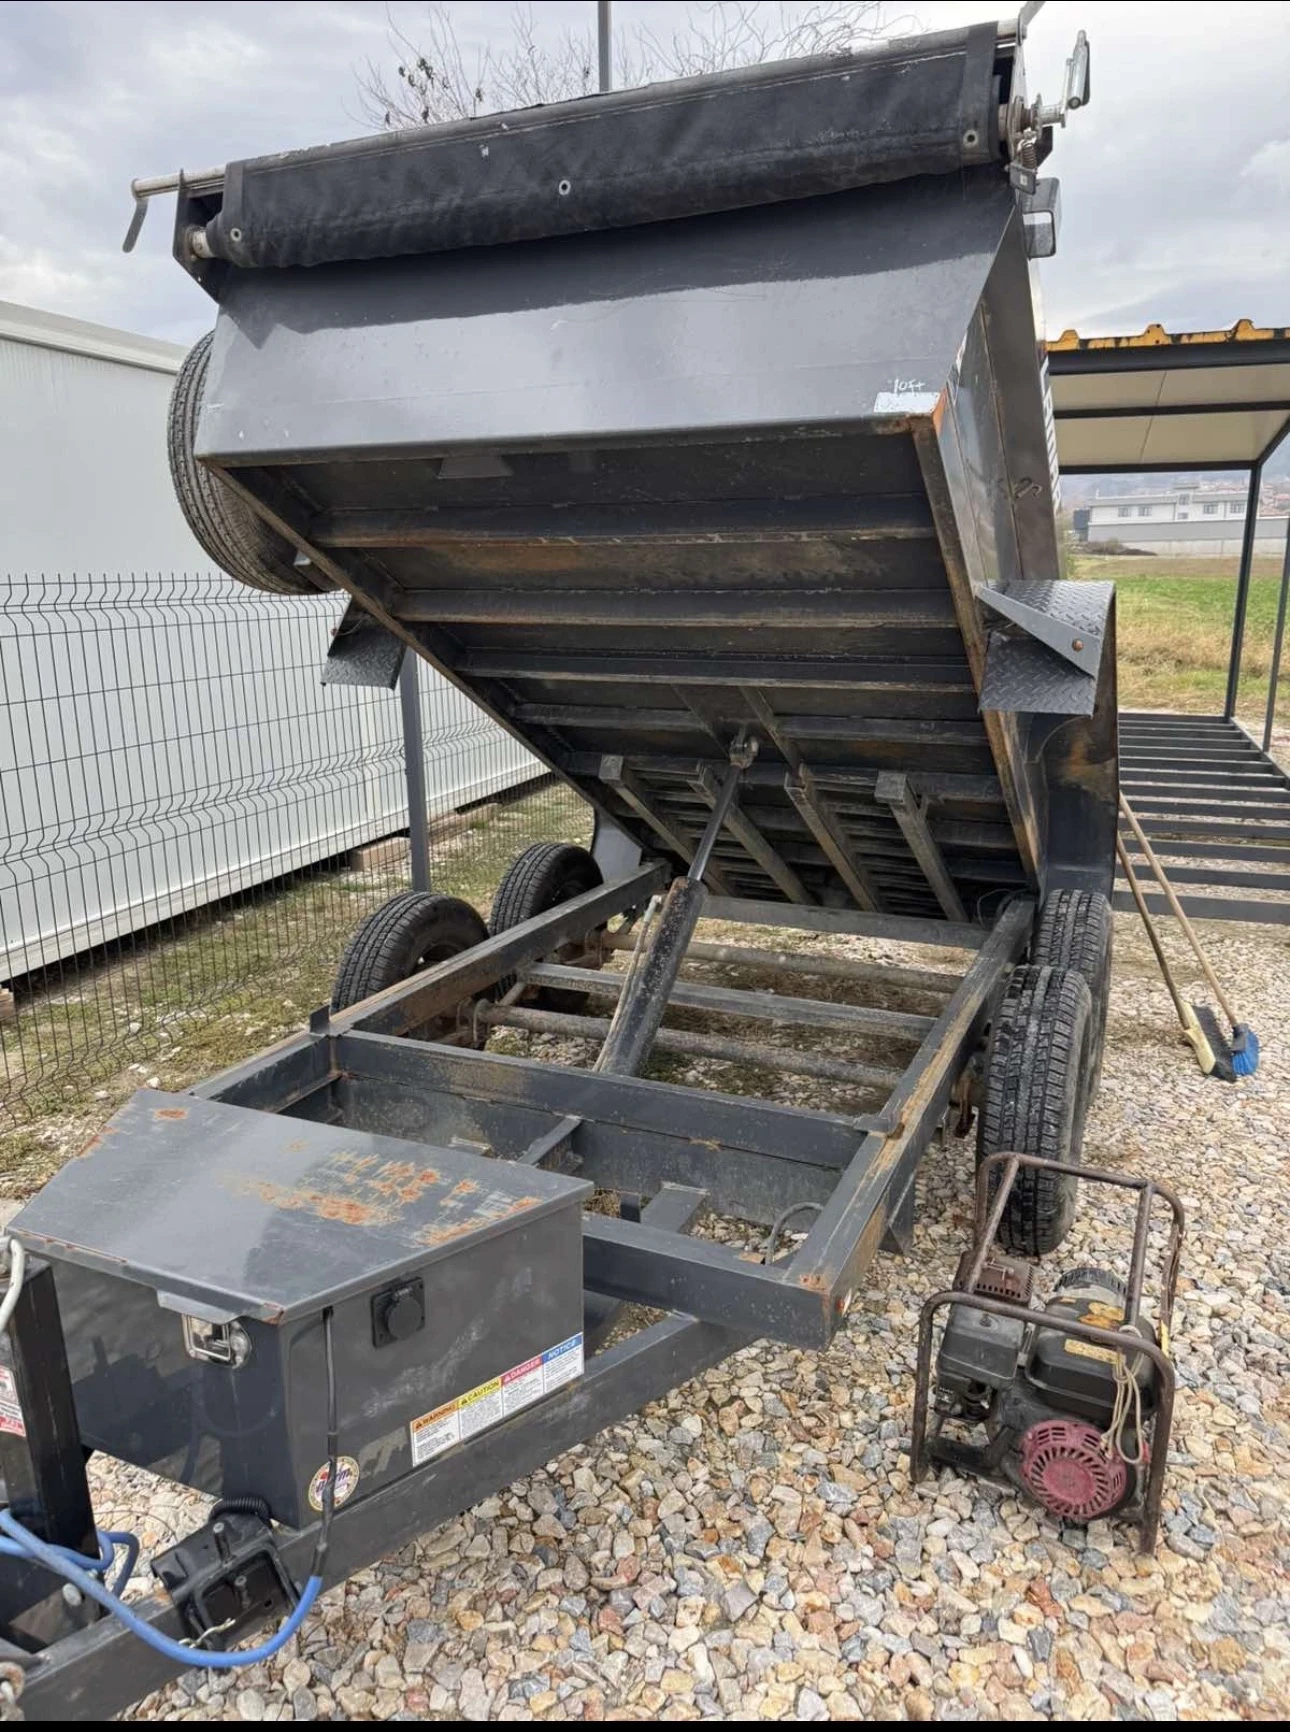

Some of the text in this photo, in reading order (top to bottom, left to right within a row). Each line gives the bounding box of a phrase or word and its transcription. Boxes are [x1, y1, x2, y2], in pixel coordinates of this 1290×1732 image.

[547, 1340, 577, 1360] NOTICE
[510, 1358, 541, 1378] DANGER
[467, 1380, 500, 1403] CAUTION
[422, 1403, 457, 1424] WARNING
